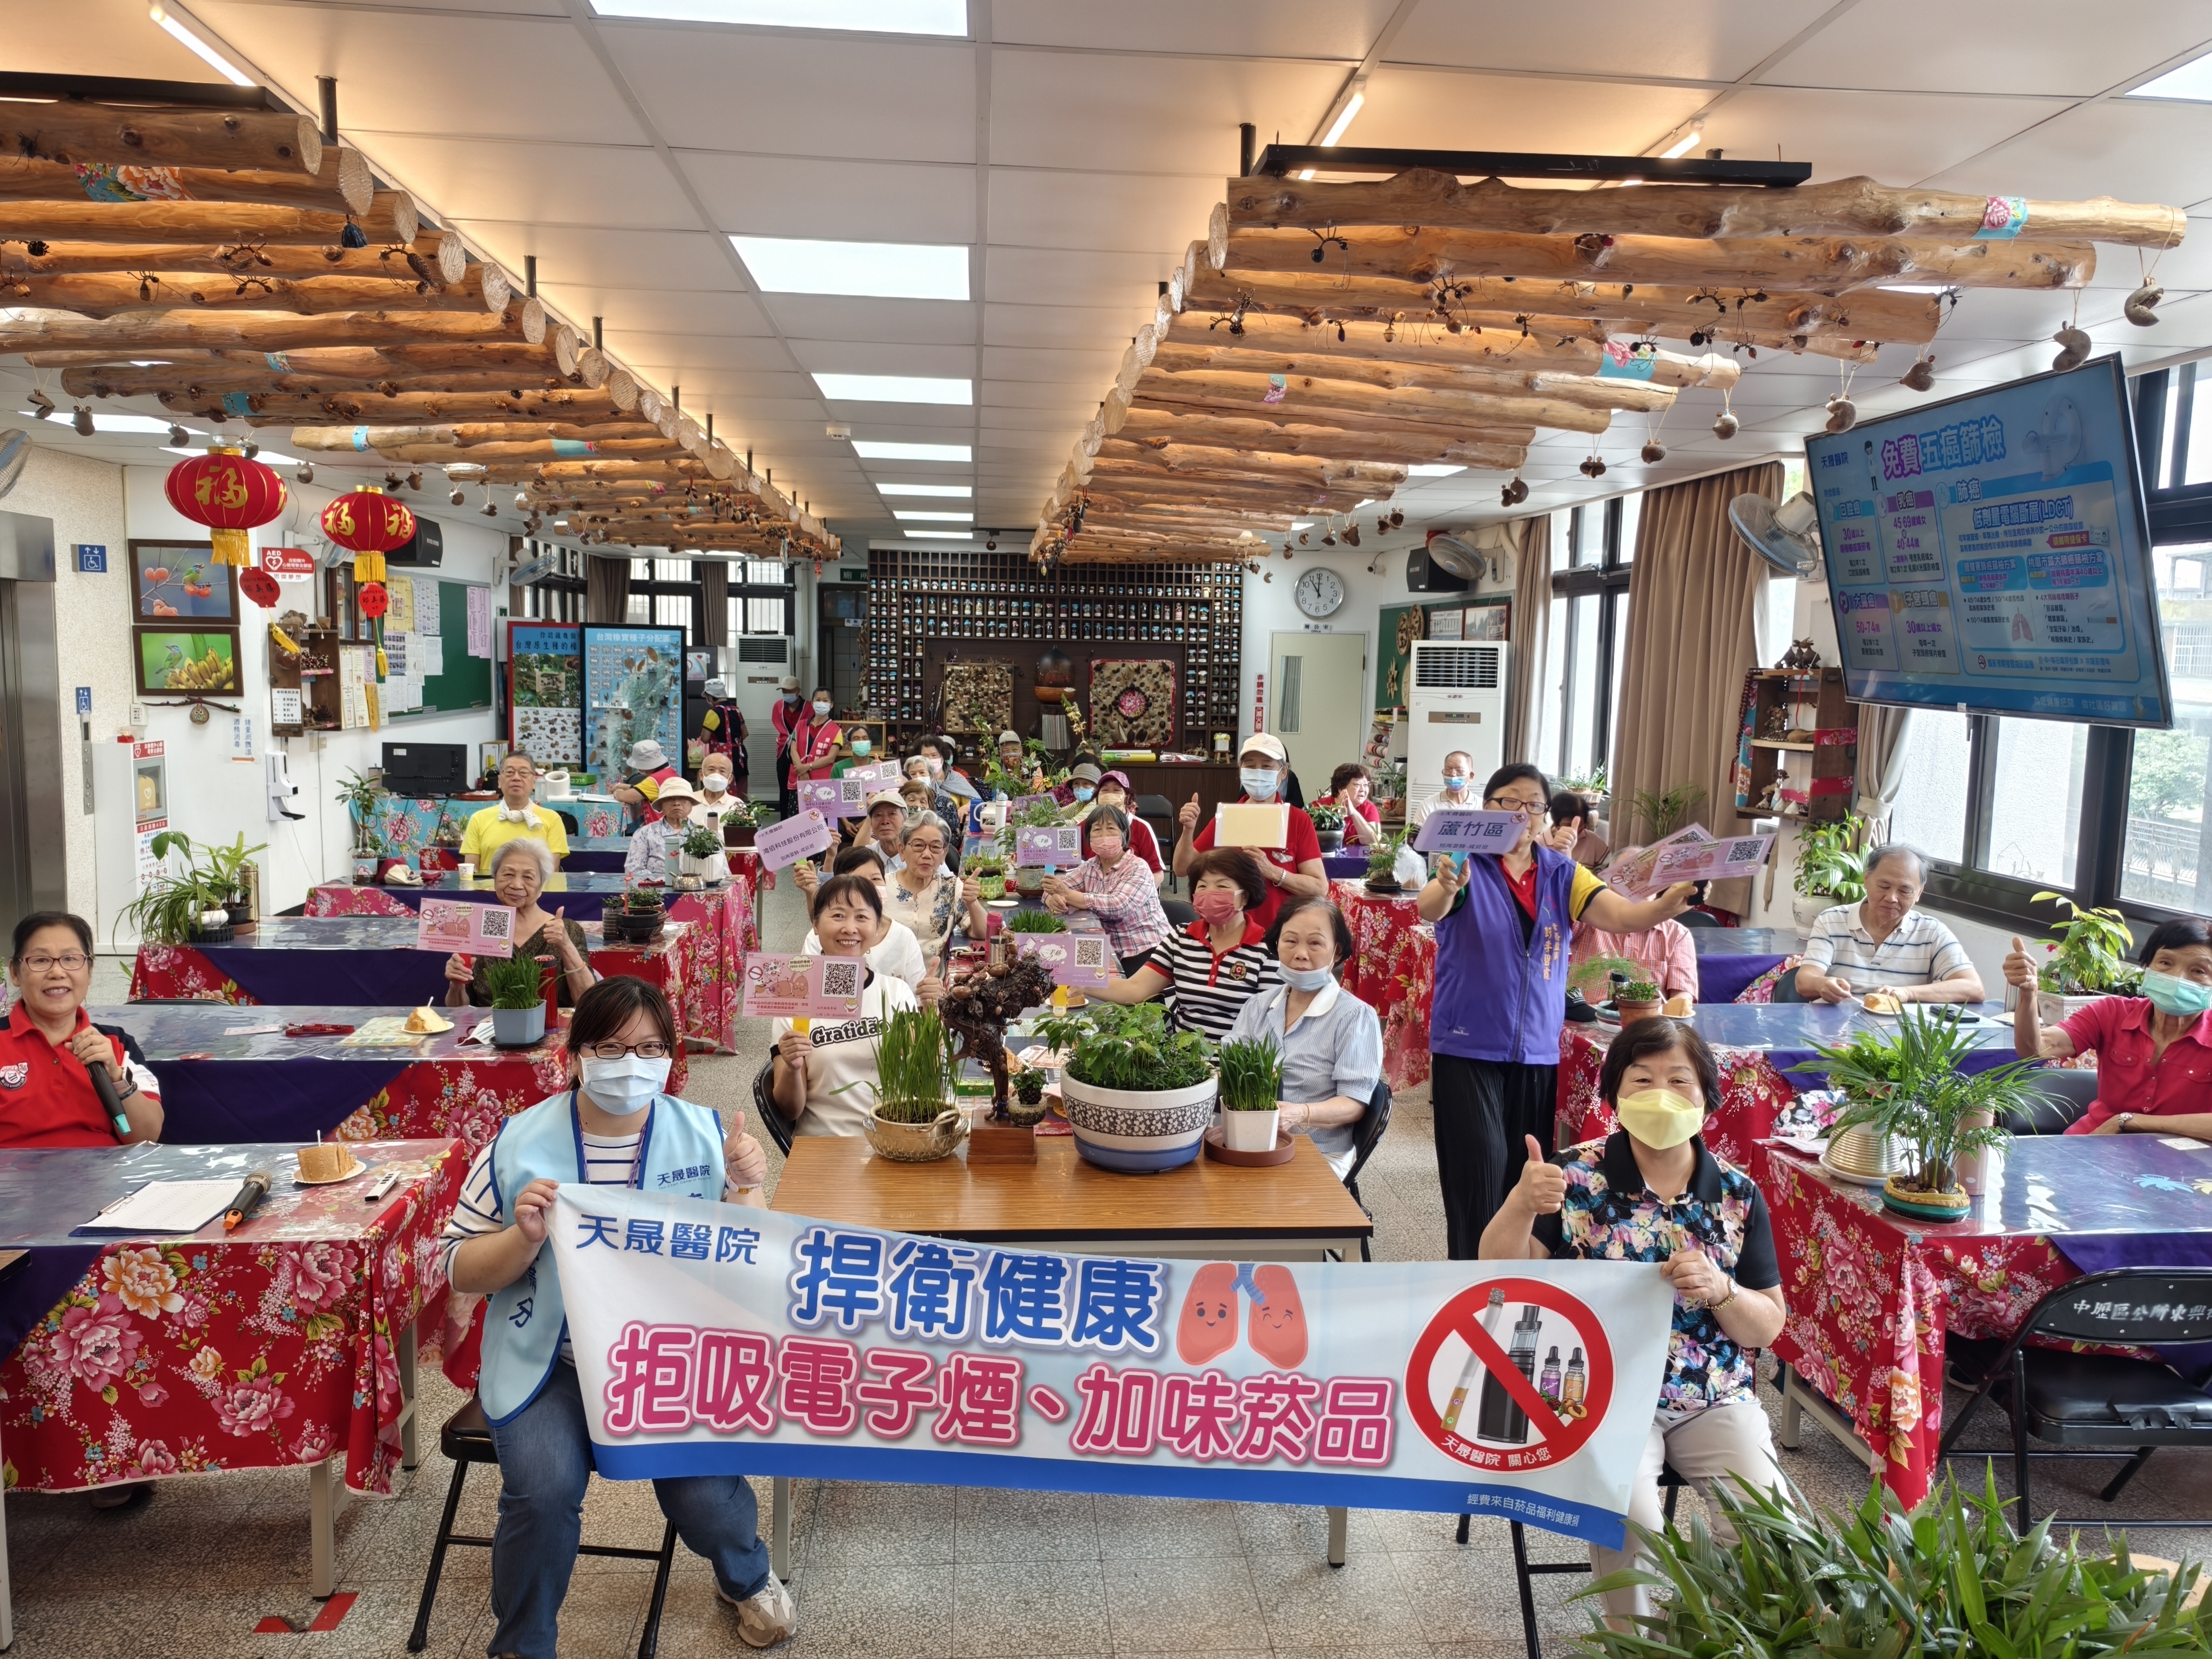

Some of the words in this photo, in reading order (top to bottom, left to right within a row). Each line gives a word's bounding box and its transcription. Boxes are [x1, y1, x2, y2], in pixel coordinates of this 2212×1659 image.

[1821, 452, 1849, 469] 天晟醫院
[1883, 417, 2005, 478] 免費五癌篩檢
[195, 466, 248, 508] 福
[1897, 490, 1914, 509] 乳癌
[1957, 478, 1981, 502] 肺癌
[325, 501, 355, 536] 福
[387, 504, 414, 538] 福
[1840, 501, 1862, 517] 口腔癌
[1973, 496, 2074, 529] 低劑量電腦斷層(LDCT)
[1853, 593, 1876, 609] 大腸癌
[1905, 591, 1939, 609] 子宮頸癌
[516, 640, 577, 651] 台灣原生種的橡
[540, 631, 580, 639] 你認識幾個
[762, 824, 825, 855] 鴻佰科技股份有限公司
[1438, 821, 1508, 837] 蘆竹區
[657, 1165, 711, 1186] 天晟醫院
[576, 1213, 761, 1265] 天晟醫院
[794, 1230, 1160, 1350] 捍衛健康
[608, 1325, 1399, 1465] 拒吸電子煙、加味菸品
[1441, 1434, 1501, 1467] 天晟醫院
[1507, 1447, 1552, 1467] 關心您
[1467, 1493, 1580, 1527] 經費來自菸品福利健康捐
